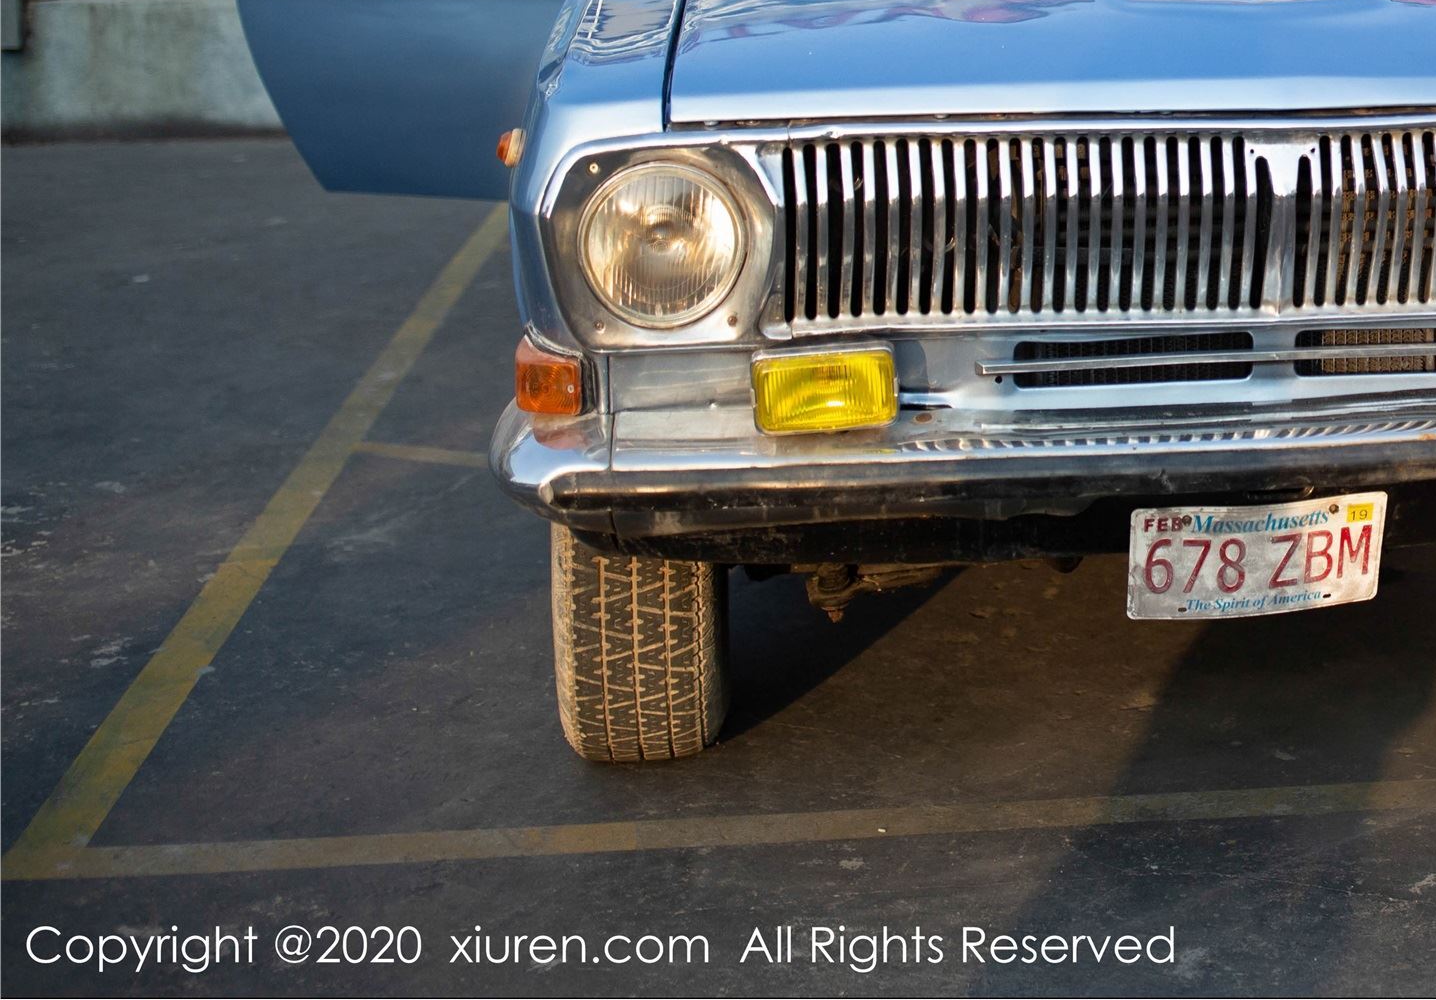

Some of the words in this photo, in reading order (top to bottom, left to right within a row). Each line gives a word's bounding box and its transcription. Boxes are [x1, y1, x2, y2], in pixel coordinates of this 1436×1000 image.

[1143, 517, 1183, 533] FEB
[1191, 511, 1330, 534] Massachusetts
[1350, 509, 1368, 521] 19
[1143, 537, 1247, 594] 678
[1268, 524, 1373, 590] ZBM
[1186, 597, 1212, 611] The
[1214, 597, 1250, 614] Spirit
[1252, 595, 1267, 610] of
[1269, 590, 1321, 606] America
